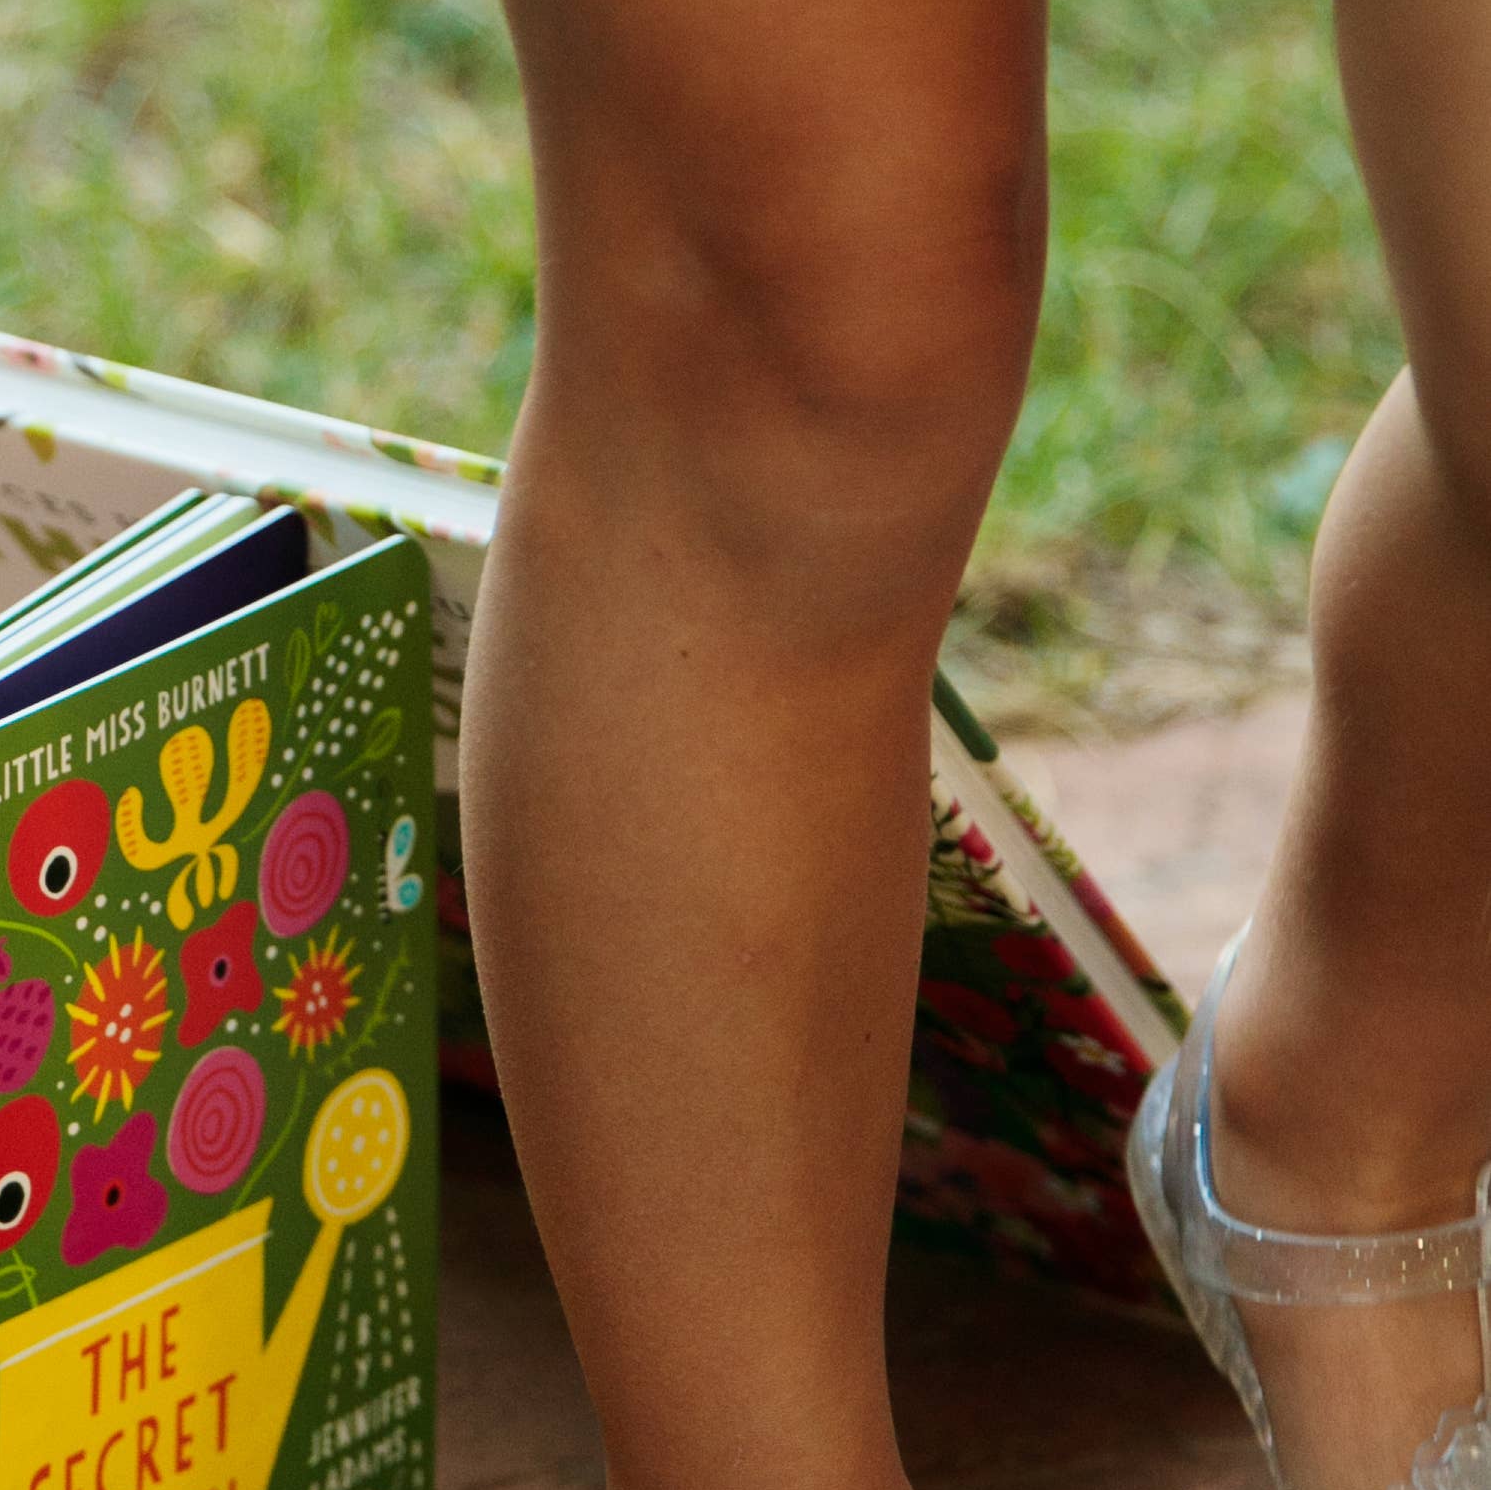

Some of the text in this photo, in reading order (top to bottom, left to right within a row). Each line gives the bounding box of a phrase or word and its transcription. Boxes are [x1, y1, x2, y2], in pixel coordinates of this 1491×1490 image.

[86, 701, 145, 764] MISS
[157, 642, 271, 730] BURNETT
[81, 1303, 180, 1416] THE
